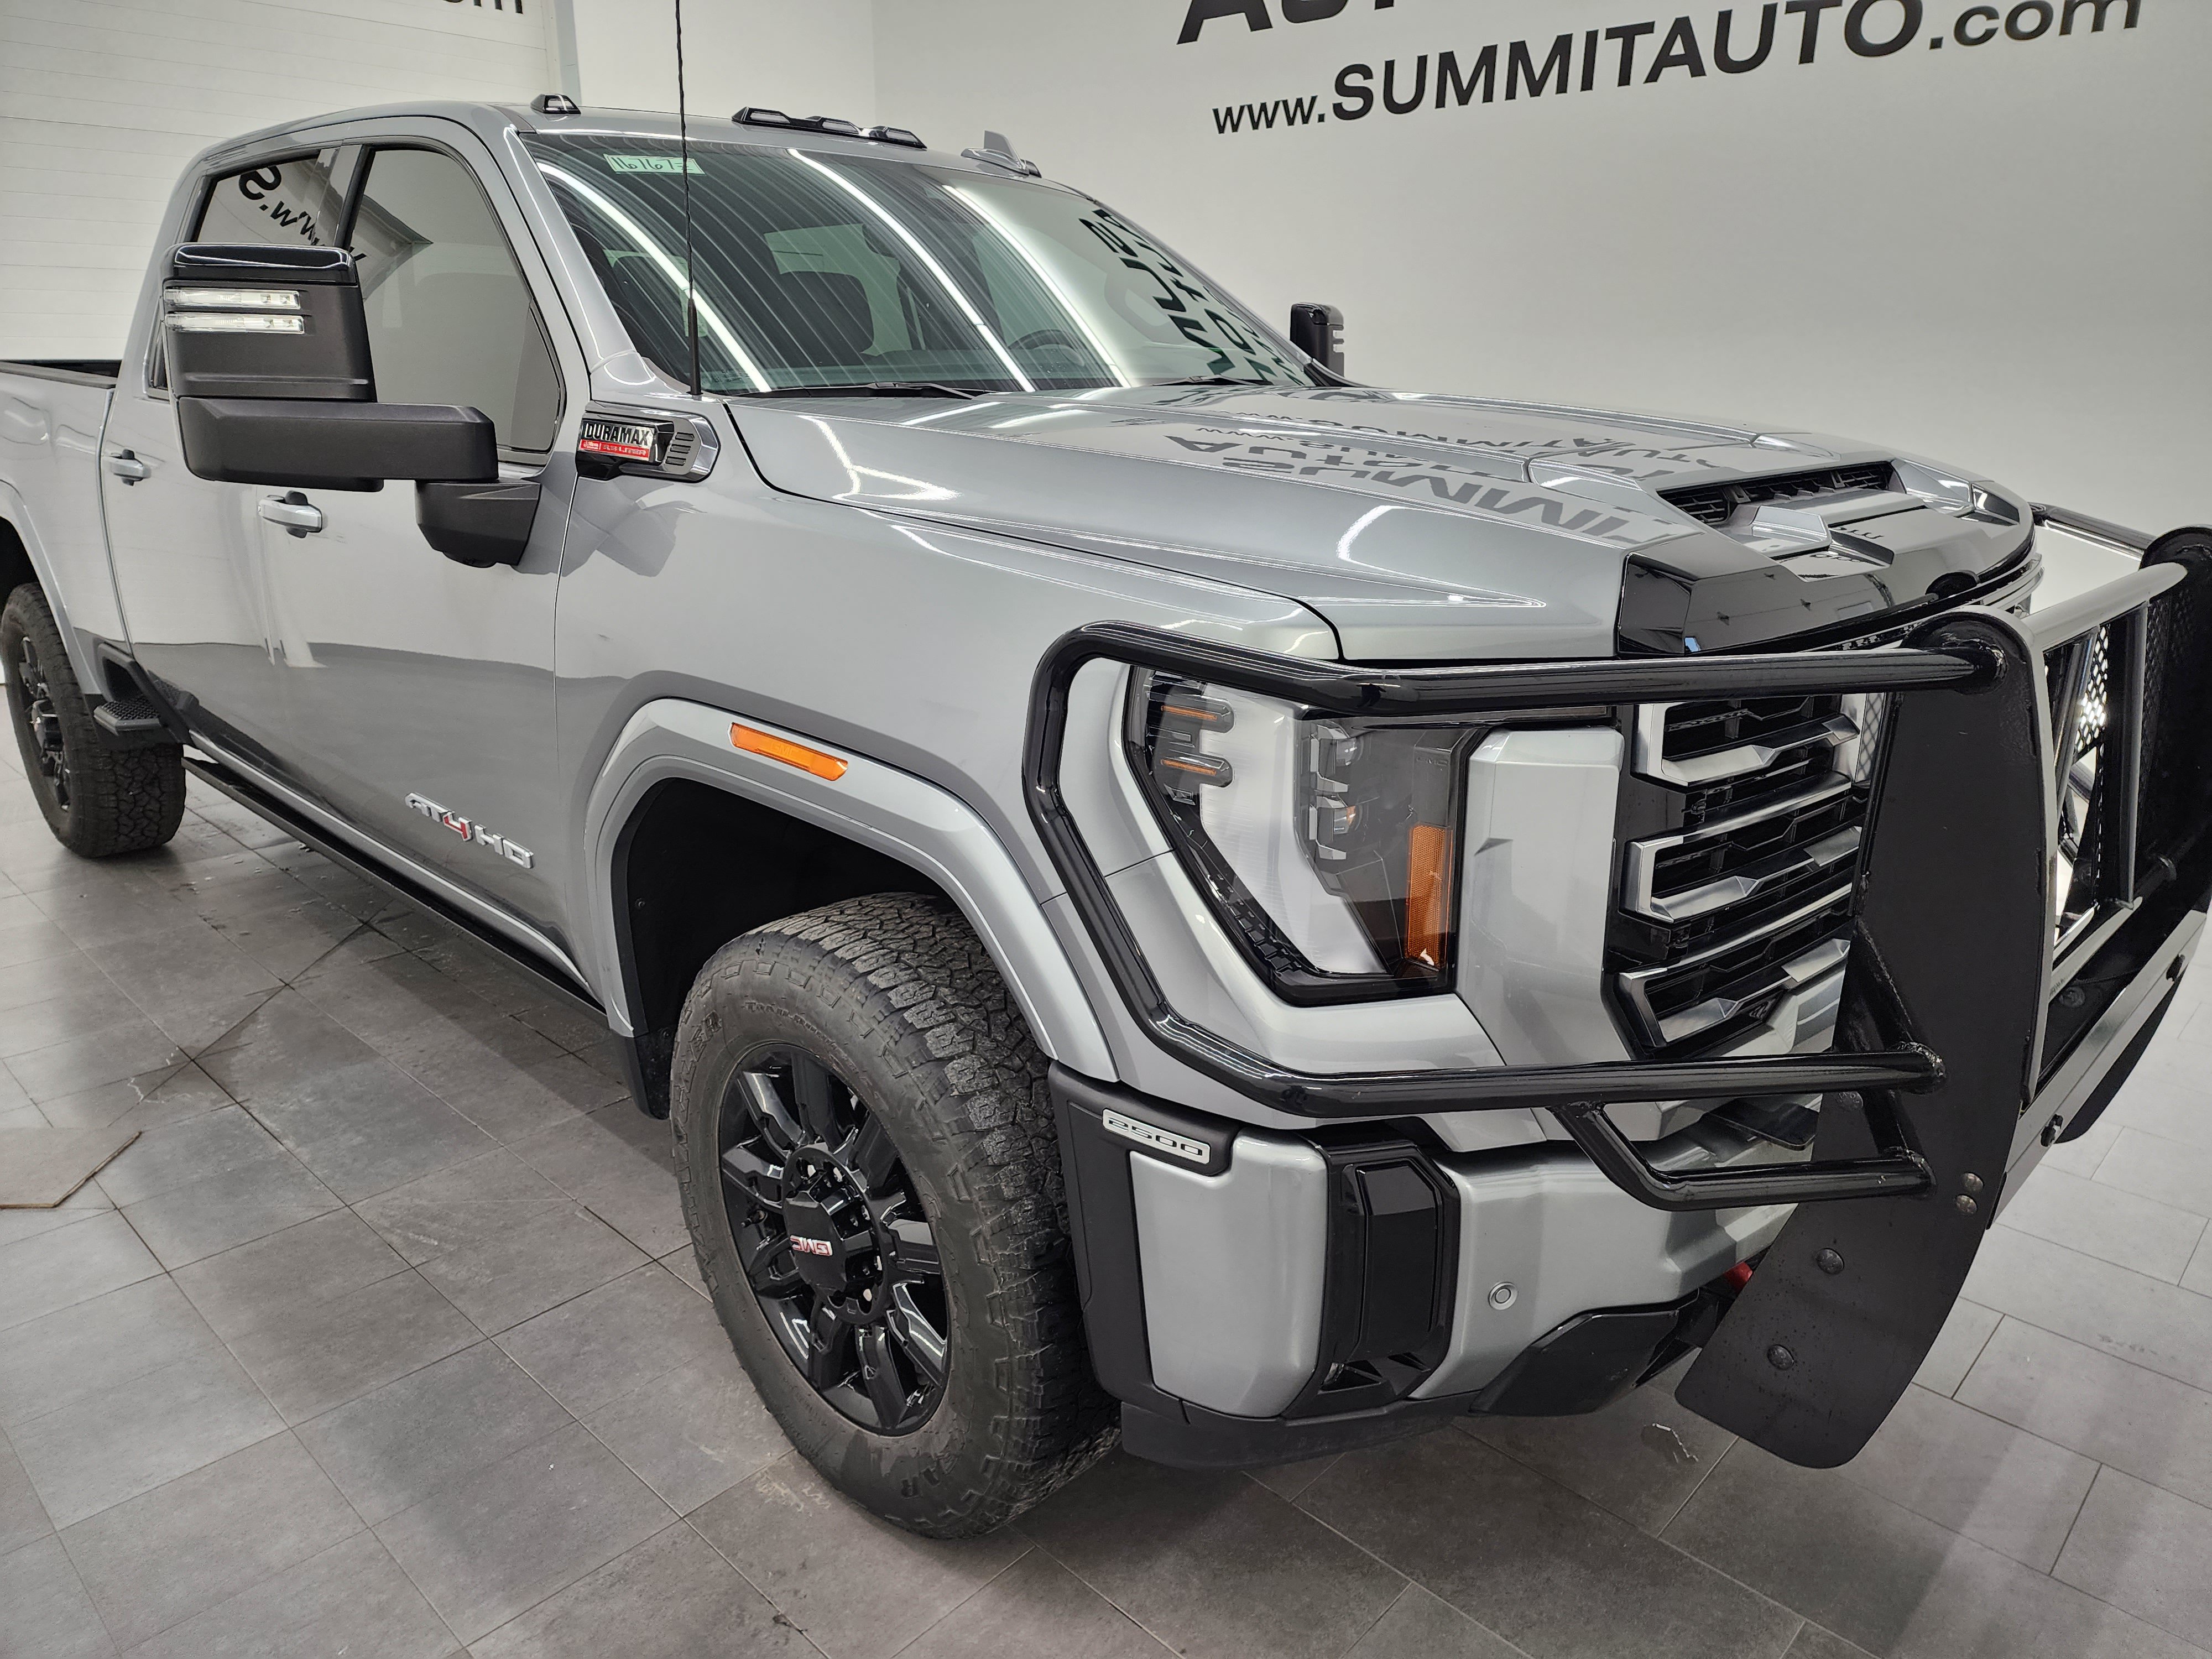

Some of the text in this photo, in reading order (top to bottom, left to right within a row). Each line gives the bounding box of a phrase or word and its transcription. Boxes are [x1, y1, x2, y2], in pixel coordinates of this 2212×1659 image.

[1212, 0, 2141, 134] www.SUMMITAUTO.com
[585, 422, 651, 447] DURAMAX
[1108, 1119, 1203, 1156] 2500
[790, 1235, 833, 1256] GMC
